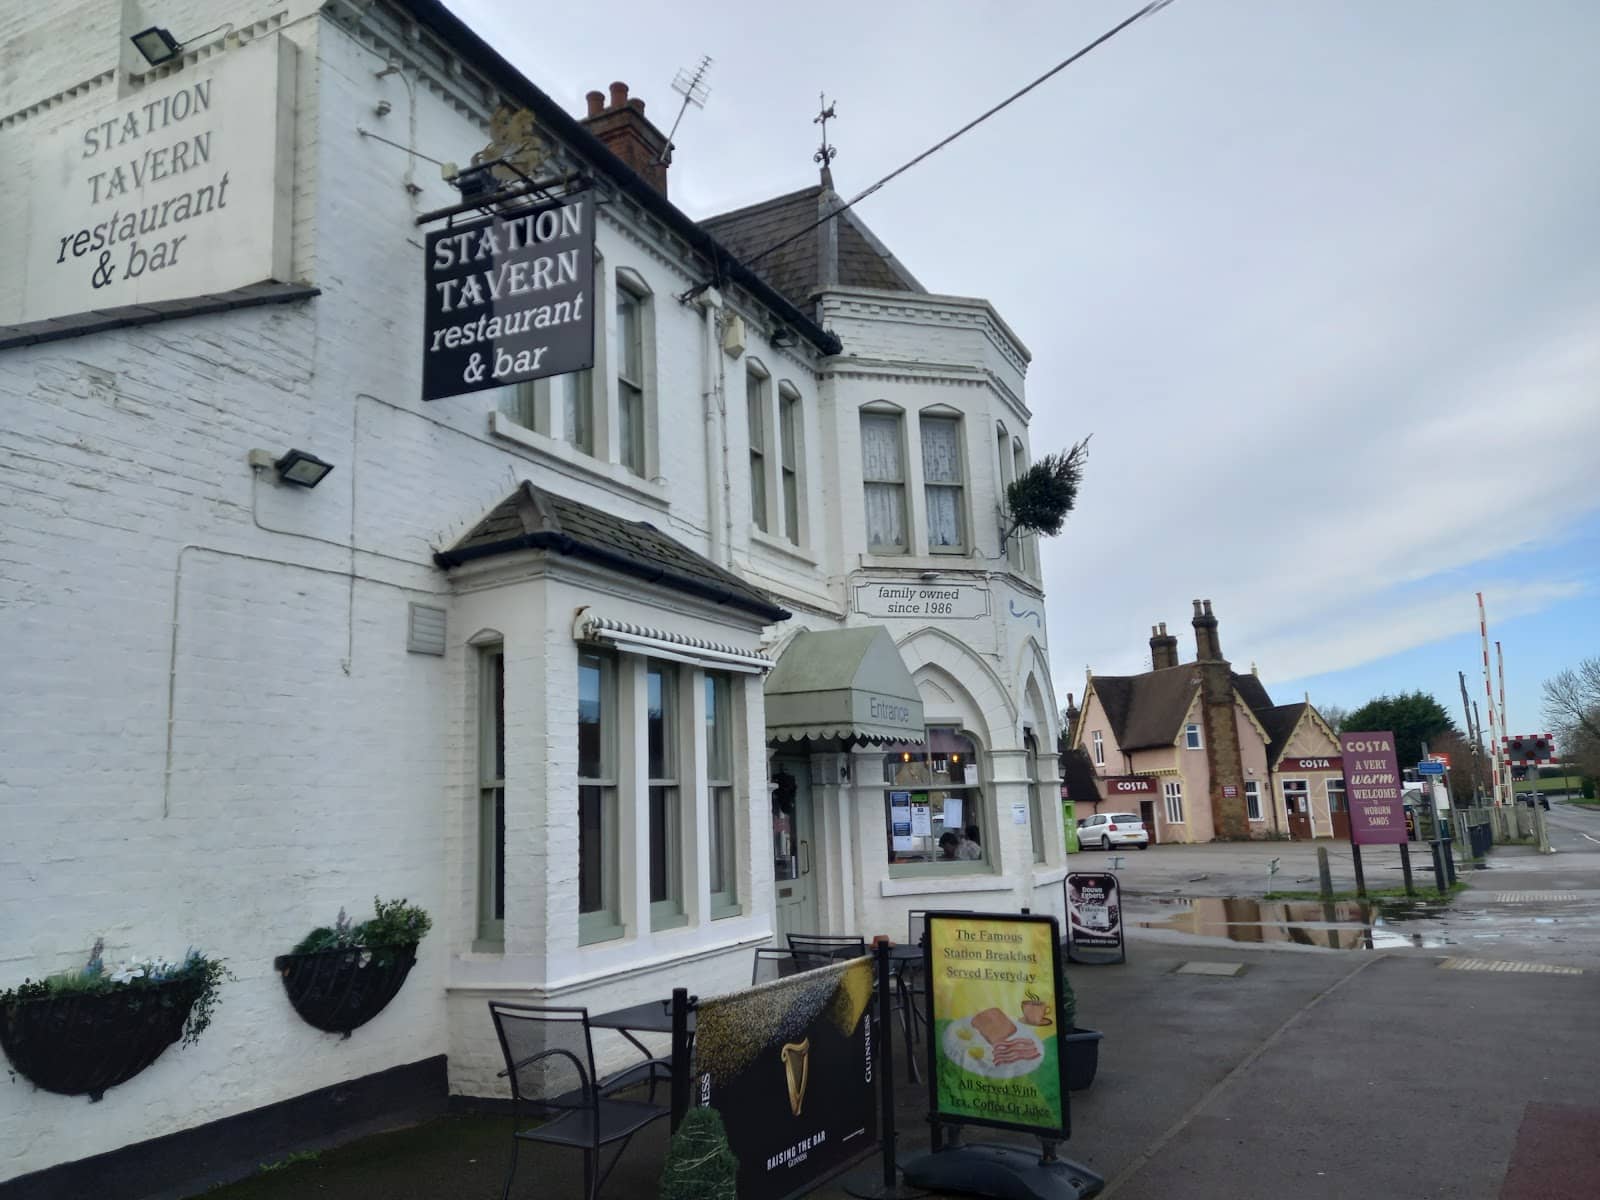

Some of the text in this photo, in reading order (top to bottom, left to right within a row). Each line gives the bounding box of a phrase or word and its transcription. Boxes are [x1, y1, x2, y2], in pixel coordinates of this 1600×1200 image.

[81, 78, 213, 160] STATION
[87, 131, 212, 205] TAVERN
[56, 170, 230, 264] restaurant
[433, 202, 583, 270] STATION
[91, 234, 187, 289] & bar
[435, 249, 579, 313] TAVERN
[430, 290, 584, 352] restaurant
[463, 346, 548, 384] & bar
[878, 586, 960, 601] family owned
[887, 602, 952, 614] since 1986
[870, 697, 909, 723] Entrance
[1346, 741, 1391, 753] COSTA
[1299, 760, 1330, 769] COSTA
[1355, 760, 1387, 770] A VERY
[1117, 782, 1149, 791] COSTA
[1351, 774, 1395, 785] warm
[1353, 788, 1397, 800] WELCOME
[1363, 805, 1391, 815] WOBURN
[1368, 816, 1389, 826] SANDS
[955, 928, 1023, 943] The Famous
[943, 947, 1038, 963] Station Breakfast
[946, 966, 1037, 984] Served Everyday
[865, 1014, 873, 1083] GUINNESS
[959, 1079, 1037, 1098] All Served With
[767, 1145, 796, 1171] RAISING
[798, 1137, 811, 1154] THE
[813, 1130, 826, 1146] BAR
